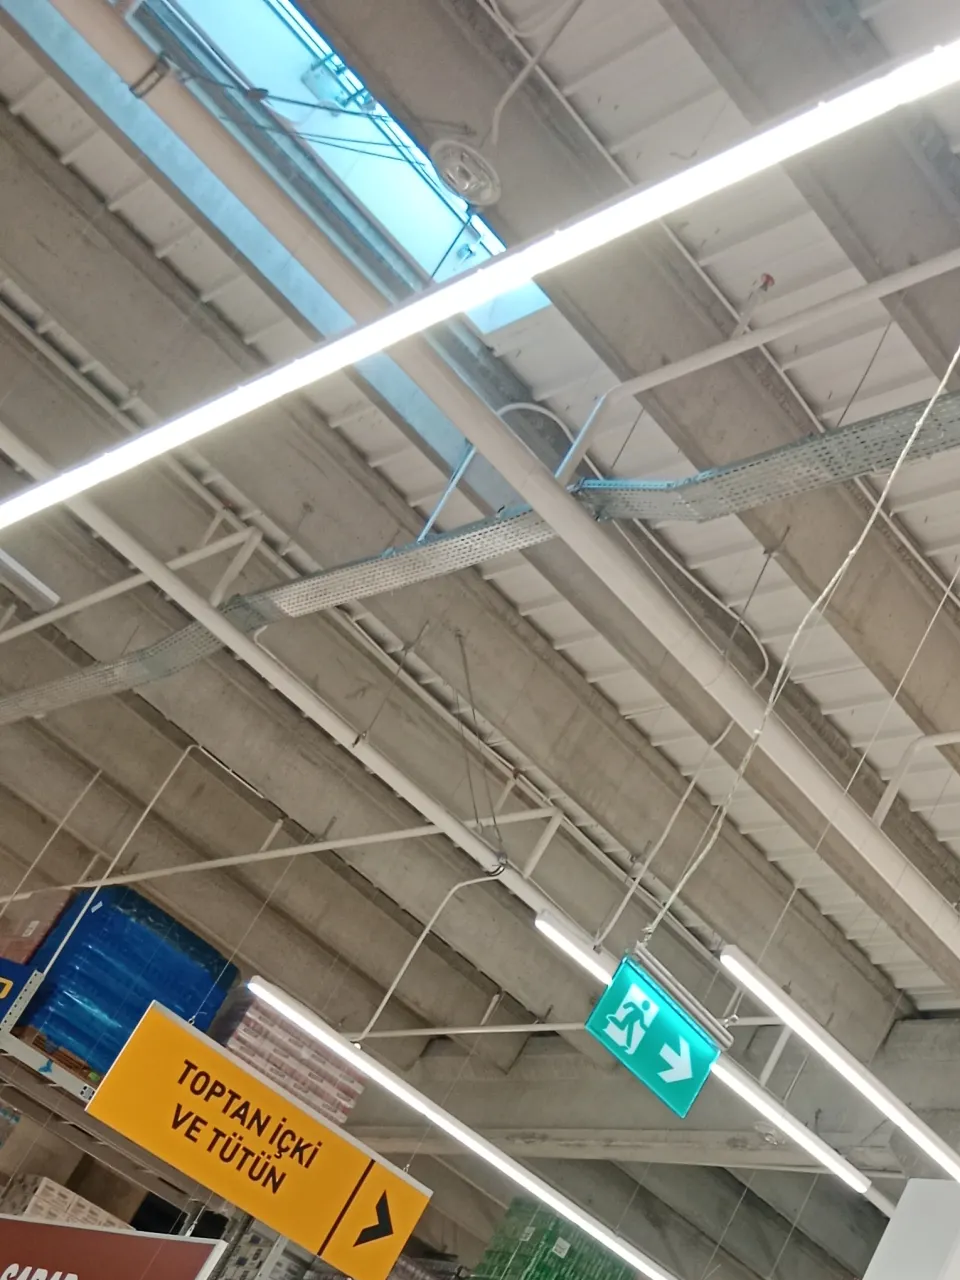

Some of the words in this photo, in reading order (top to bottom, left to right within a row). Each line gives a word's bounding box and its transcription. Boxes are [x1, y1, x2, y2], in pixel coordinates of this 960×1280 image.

[171, 1103, 208, 1143] VE
[206, 1127, 287, 1195] TÜTÜN
[177, 1059, 272, 1138] TOPTAN
[268, 1117, 323, 1169] İÇKİ
